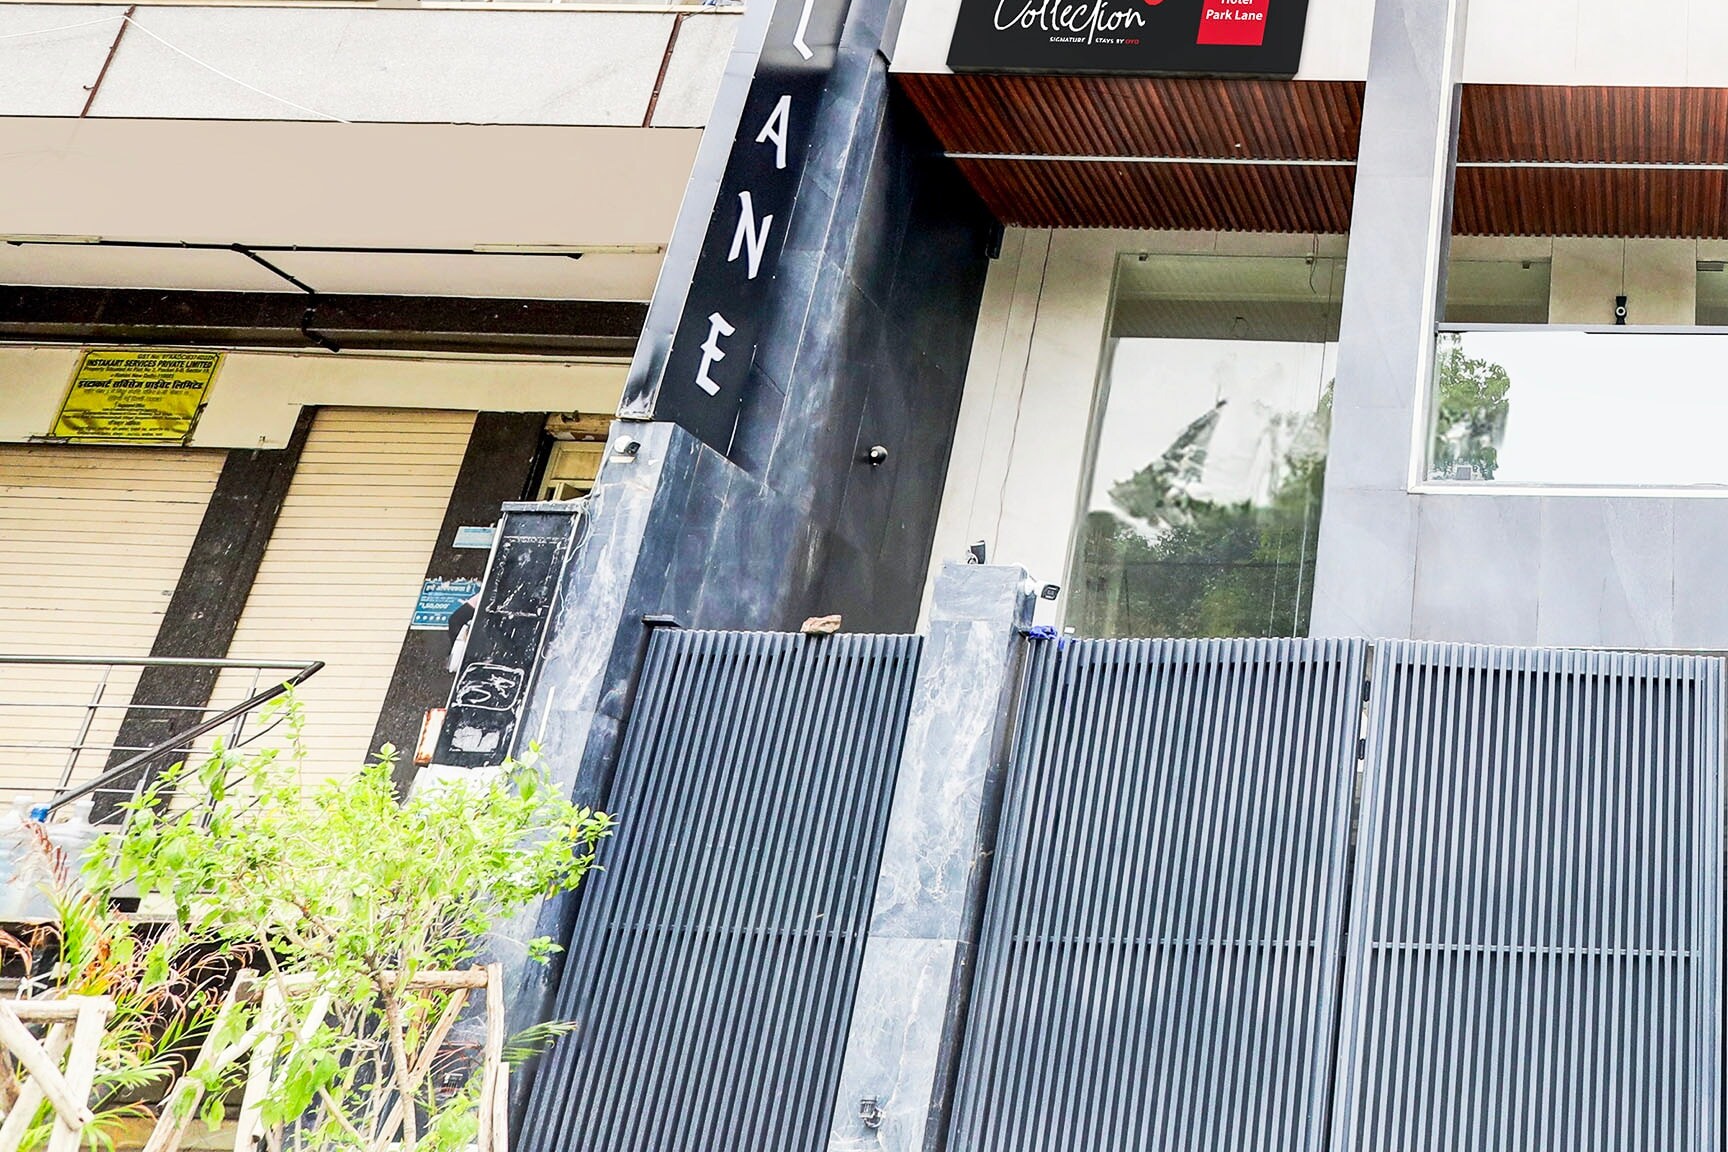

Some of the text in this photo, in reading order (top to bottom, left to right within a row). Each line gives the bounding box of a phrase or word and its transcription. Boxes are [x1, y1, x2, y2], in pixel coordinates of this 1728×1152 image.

[1206, 9, 1263, 20] Park Lane
[86, 359, 213, 369] INSTAKART SERVICES PRIVATE LIMITED
